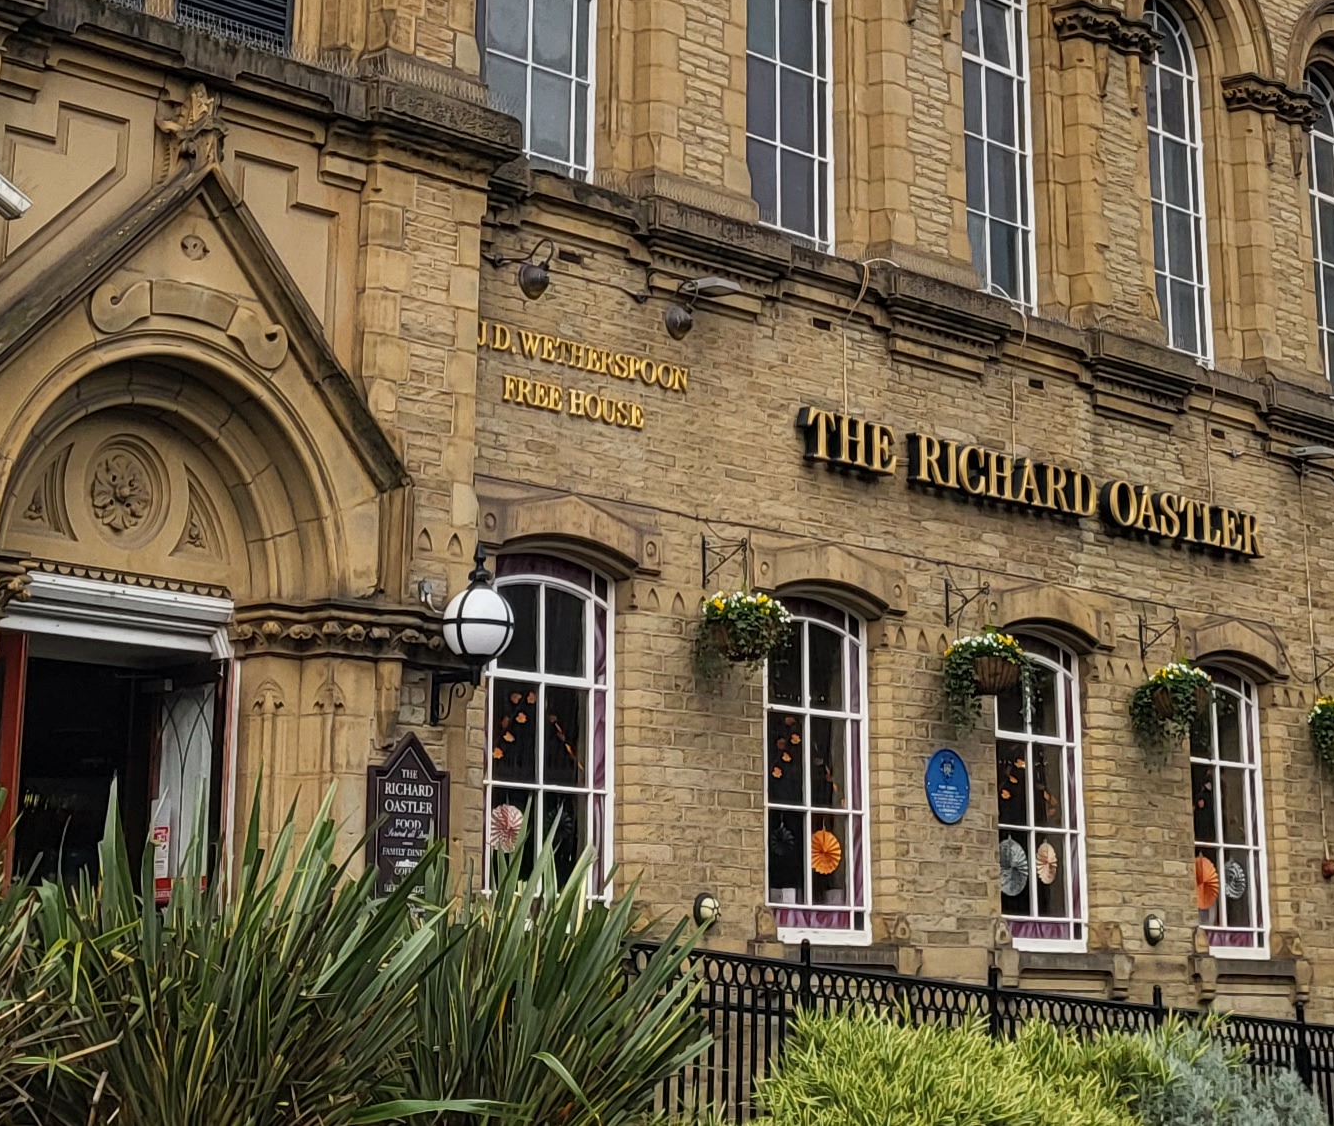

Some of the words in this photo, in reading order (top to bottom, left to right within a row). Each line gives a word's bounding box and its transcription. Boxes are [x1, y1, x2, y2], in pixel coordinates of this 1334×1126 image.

[518, 330, 689, 393] WETHERSPOON
[502, 374, 563, 412] FREE
[568, 388, 645, 430] HOUSE
[805, 406, 897, 474] THE
[914, 432, 1097, 517] RICHARD
[1109, 480, 1264, 558] OASTLER
[401, 769, 418, 779] THE
[384, 782, 434, 797] RICHARD
[384, 799, 433, 814] OASTLER
[395, 819, 422, 829] FOOD
[382, 847, 406, 856] FAMILY
